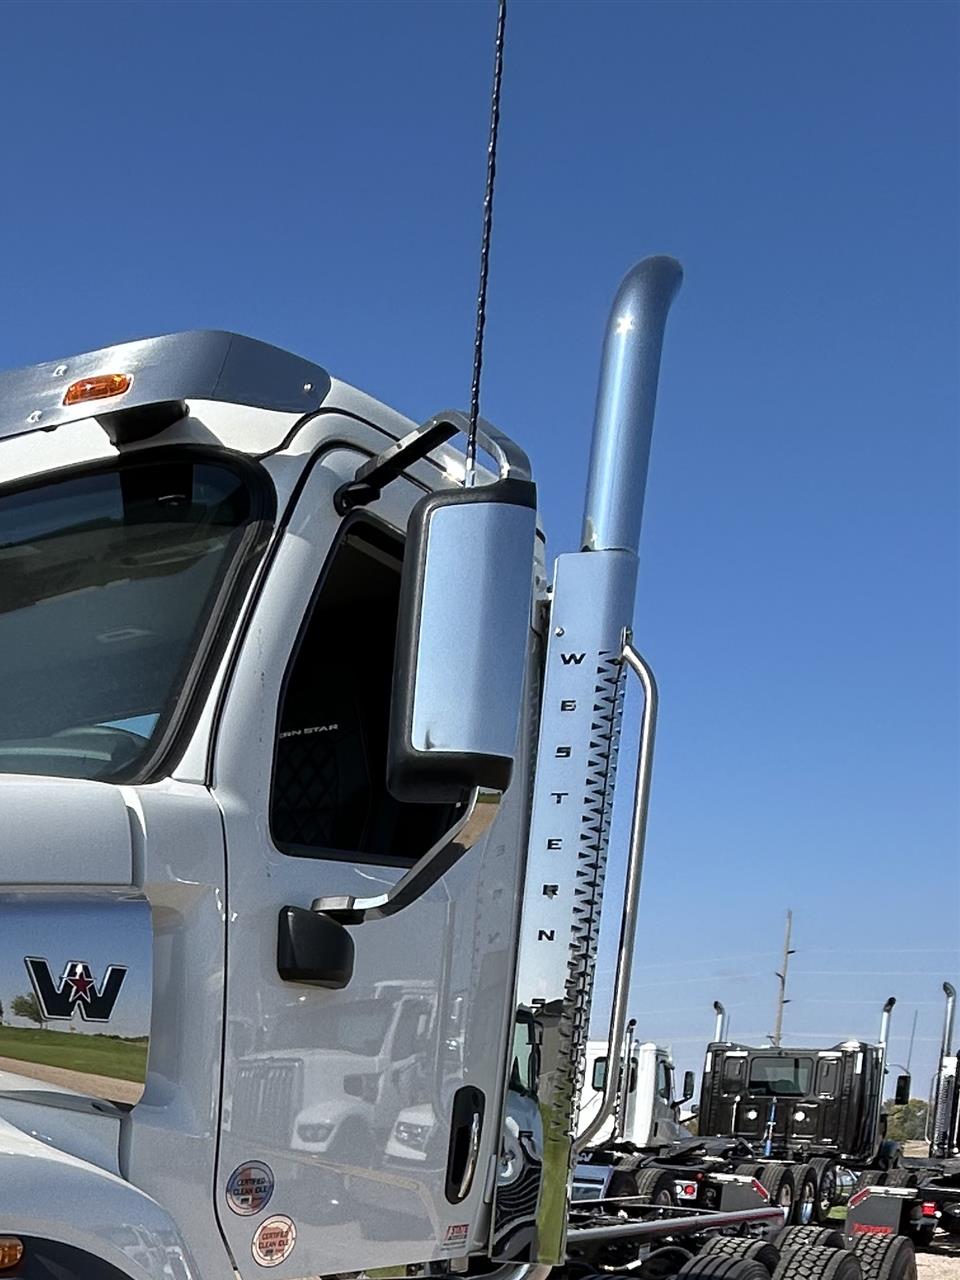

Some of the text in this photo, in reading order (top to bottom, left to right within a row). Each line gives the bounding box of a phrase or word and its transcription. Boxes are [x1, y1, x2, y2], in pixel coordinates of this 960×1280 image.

[303, 724, 338, 734] STAR
[536, 652, 586, 942] WESTERN
[237, 1177, 267, 1187] CERTIFIED
[233, 1185, 268, 1196] CLEAN IDLE
[261, 1230, 290, 1241] CERTIFIED
[258, 1238, 290, 1249] CLEAN IDLE
